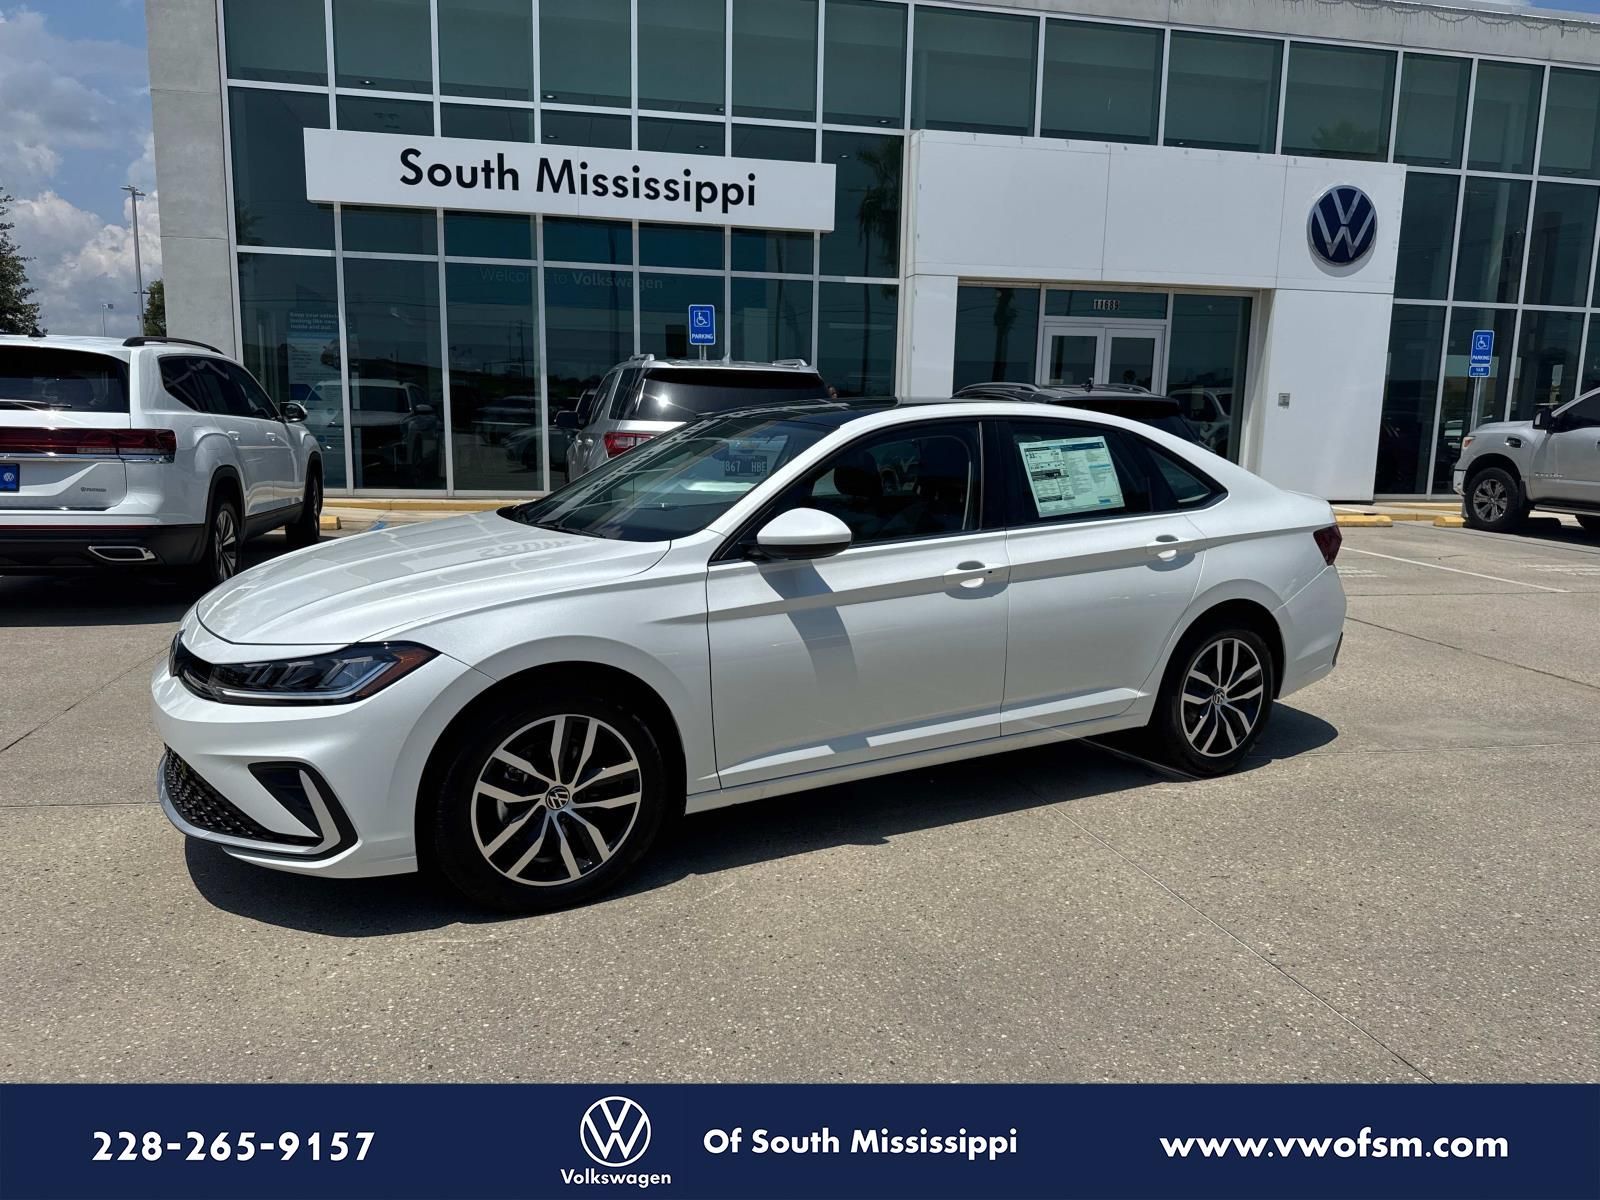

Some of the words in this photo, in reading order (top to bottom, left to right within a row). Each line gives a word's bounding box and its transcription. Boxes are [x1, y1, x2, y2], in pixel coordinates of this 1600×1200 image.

[400, 148, 519, 191] South
[536, 157, 756, 214] Mississippi
[480, 266, 549, 285] Welco
